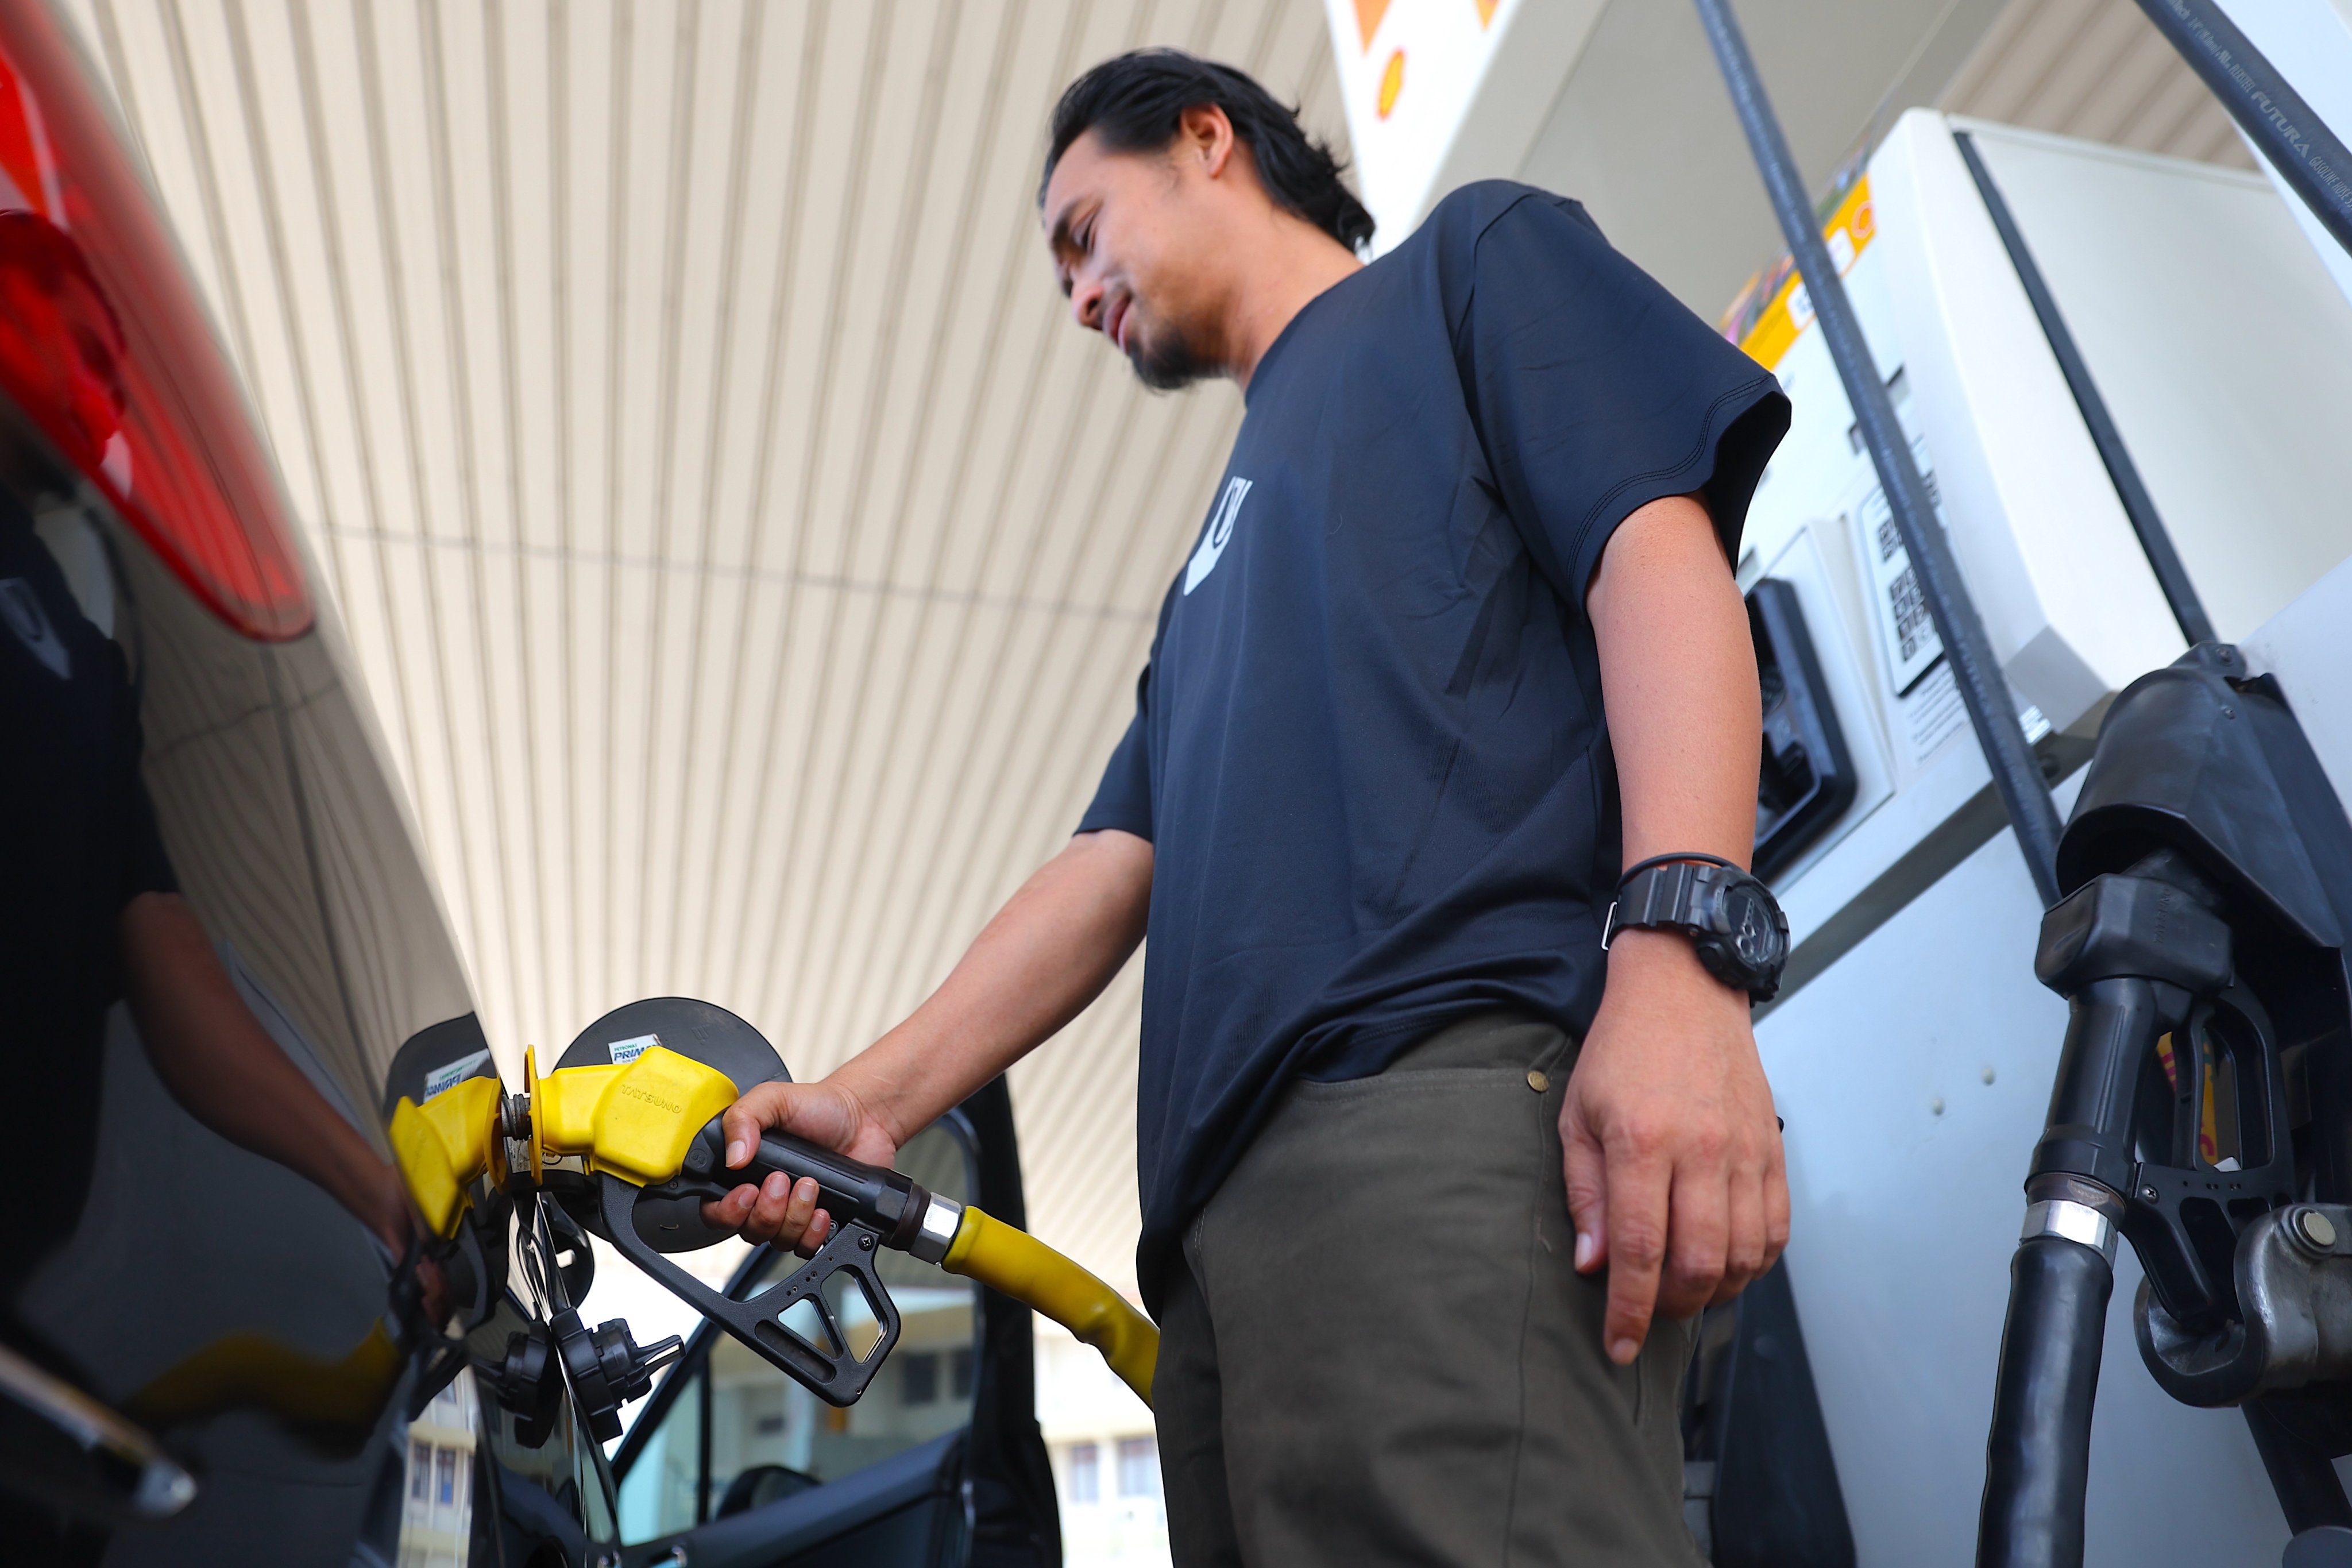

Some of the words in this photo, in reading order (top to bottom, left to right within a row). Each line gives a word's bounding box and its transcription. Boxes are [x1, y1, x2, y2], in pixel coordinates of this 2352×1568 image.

[2251, 91, 2309, 159] FUTURA
[2309, 156, 2340, 185] GASOLINE
[2332, 181, 2352, 200] HOSE
[621, 1084, 682, 1114] TATSUNO
